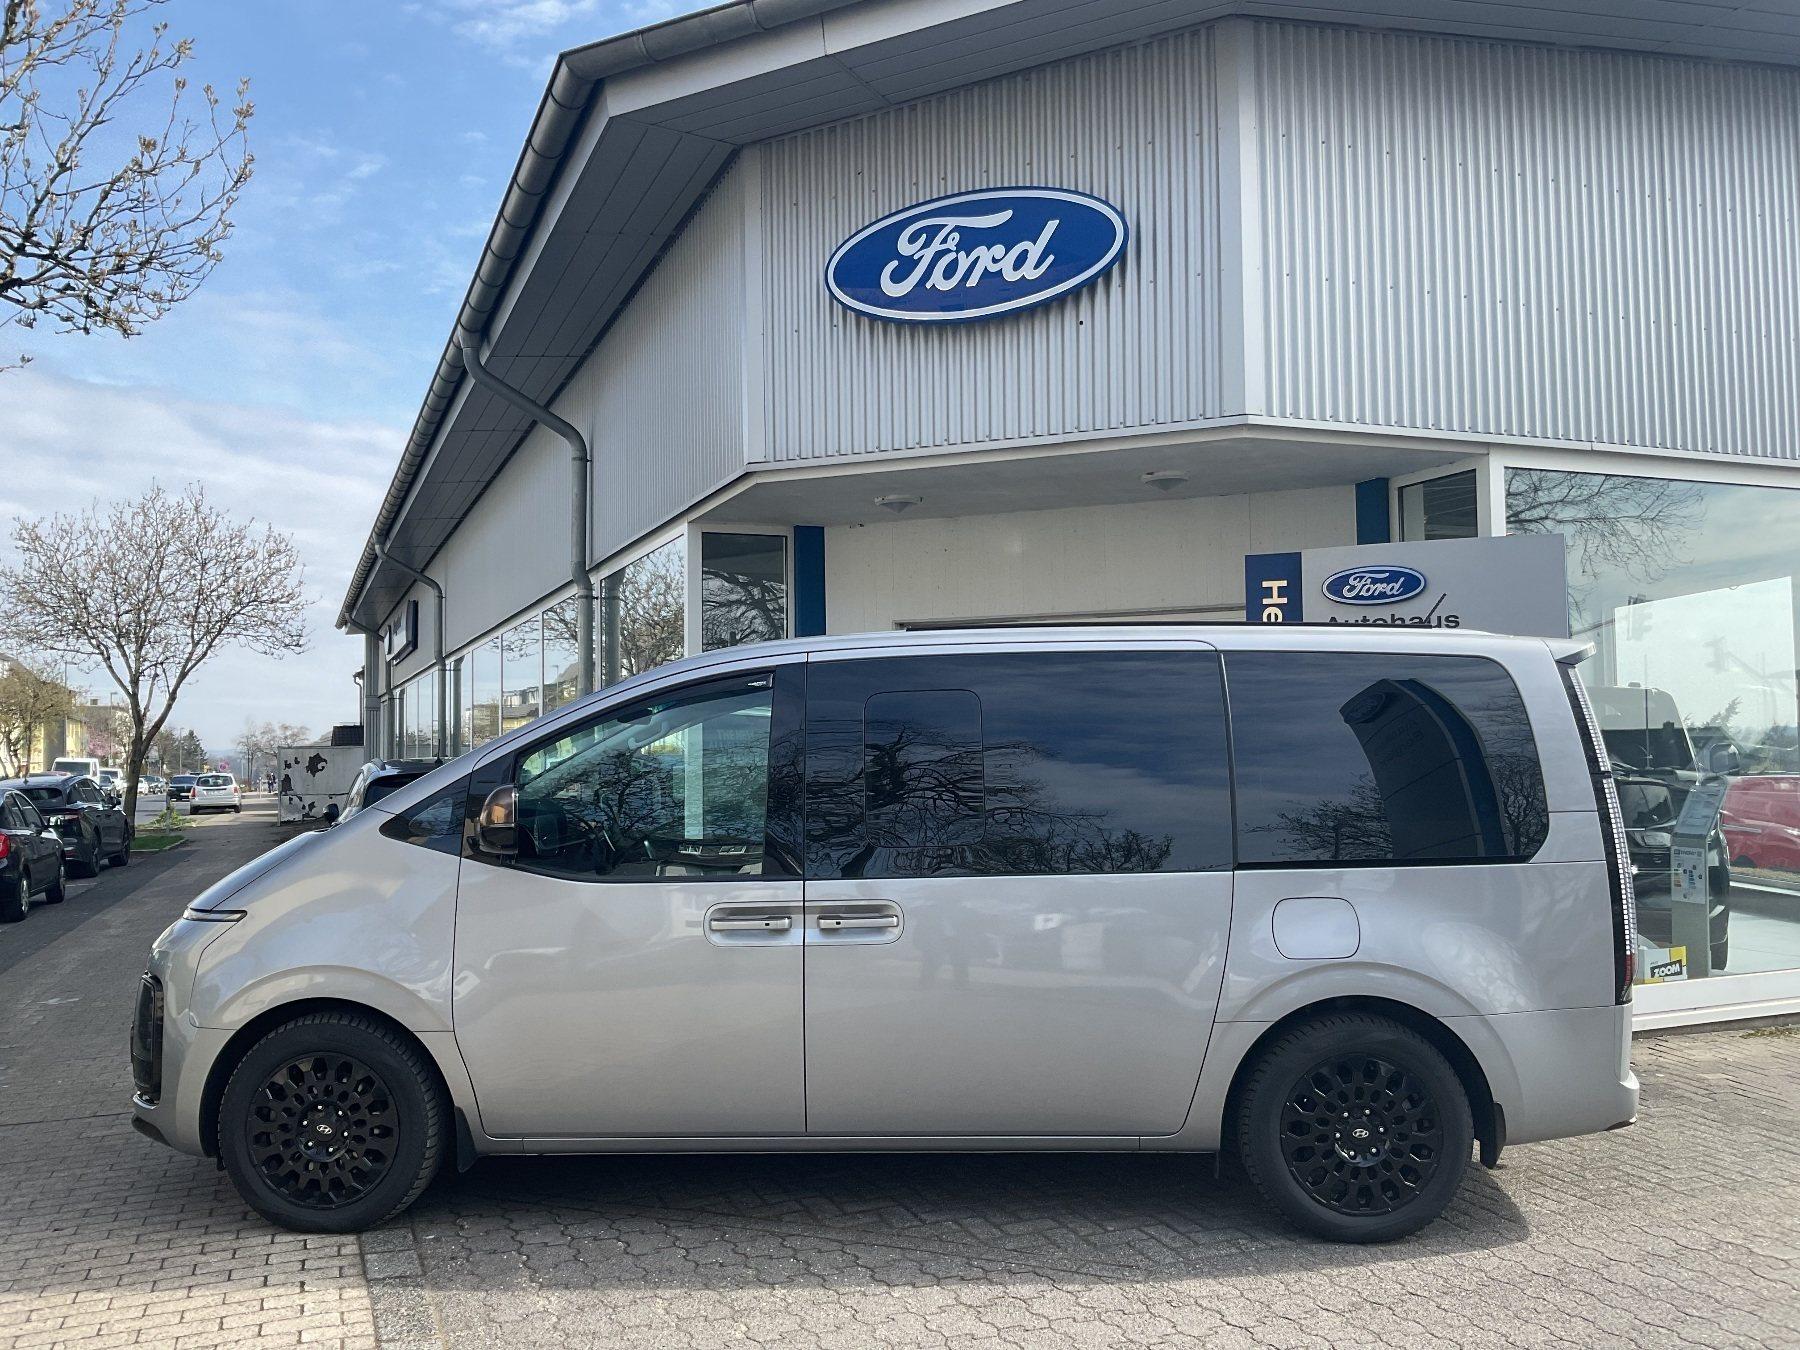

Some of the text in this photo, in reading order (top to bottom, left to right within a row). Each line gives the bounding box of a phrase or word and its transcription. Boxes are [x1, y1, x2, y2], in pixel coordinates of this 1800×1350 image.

[880, 209, 1060, 298] Ford
[1342, 572, 1405, 598] Ford
[1653, 962, 1681, 978] ZOOM
